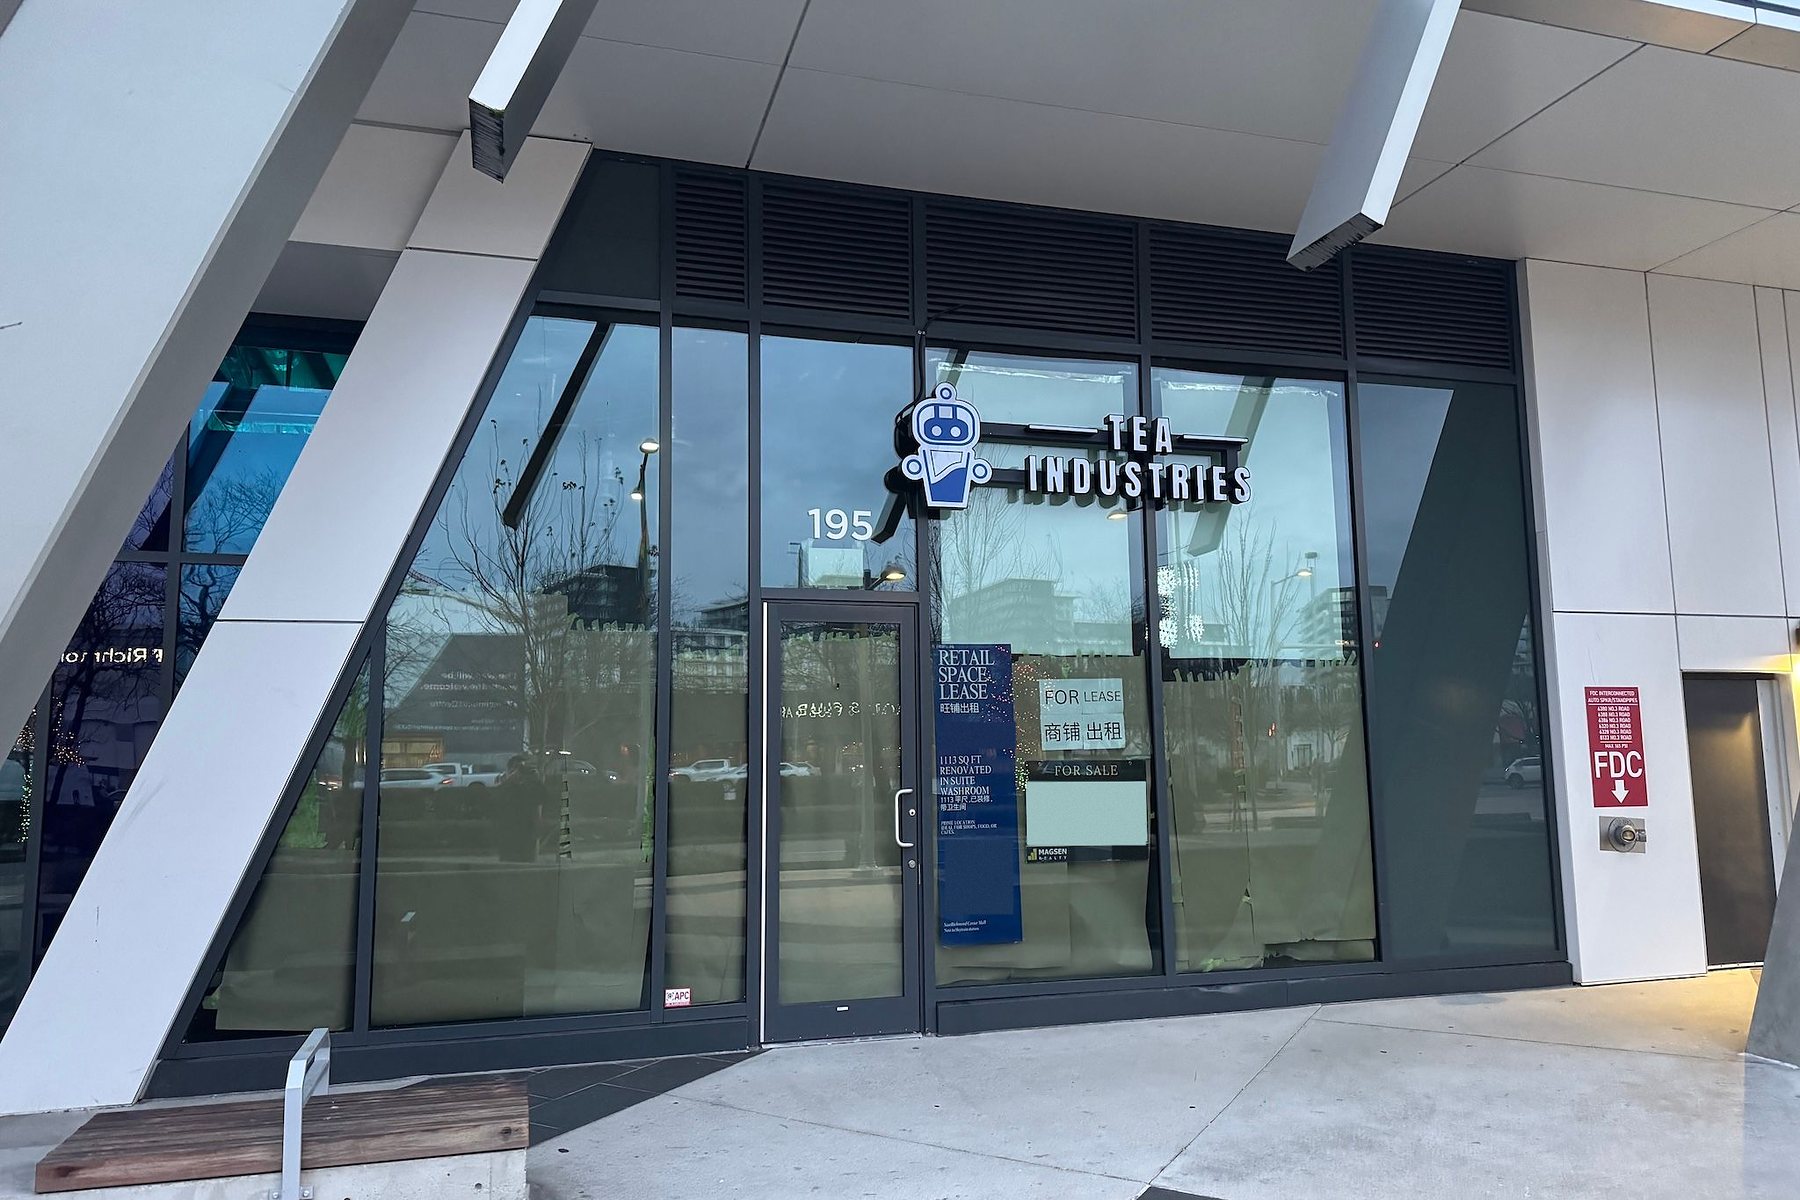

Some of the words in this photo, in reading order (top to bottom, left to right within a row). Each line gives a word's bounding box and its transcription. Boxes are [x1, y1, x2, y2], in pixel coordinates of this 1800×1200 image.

[1105, 413, 1173, 453] TEA
[1025, 455, 1253, 504] INDUSTRIES
[807, 508, 873, 541] 195
[938, 649, 996, 666] RETAIL
[938, 666, 988, 683] SPACE
[939, 683, 988, 700] LEASE
[1045, 689, 1080, 705] FOR
[1083, 690, 1122, 703] LEASE
[940, 702, 980, 714] 旺铺出租
[940, 756, 957, 765] 1113
[958, 755, 969, 765] SQ
[971, 755, 982, 764] FT
[1594, 751, 1643, 778] FDC
[940, 765, 992, 775] RENOVATED
[1055, 765, 1081, 776] FOR
[1086, 764, 1119, 776] SALE
[940, 776, 949, 785] IN
[950, 776, 975, 785] SUITE
[940, 786, 990, 796] WASHROOM
[1038, 848, 1067, 856] MAGSEN
[674, 991, 689, 1000] APC
